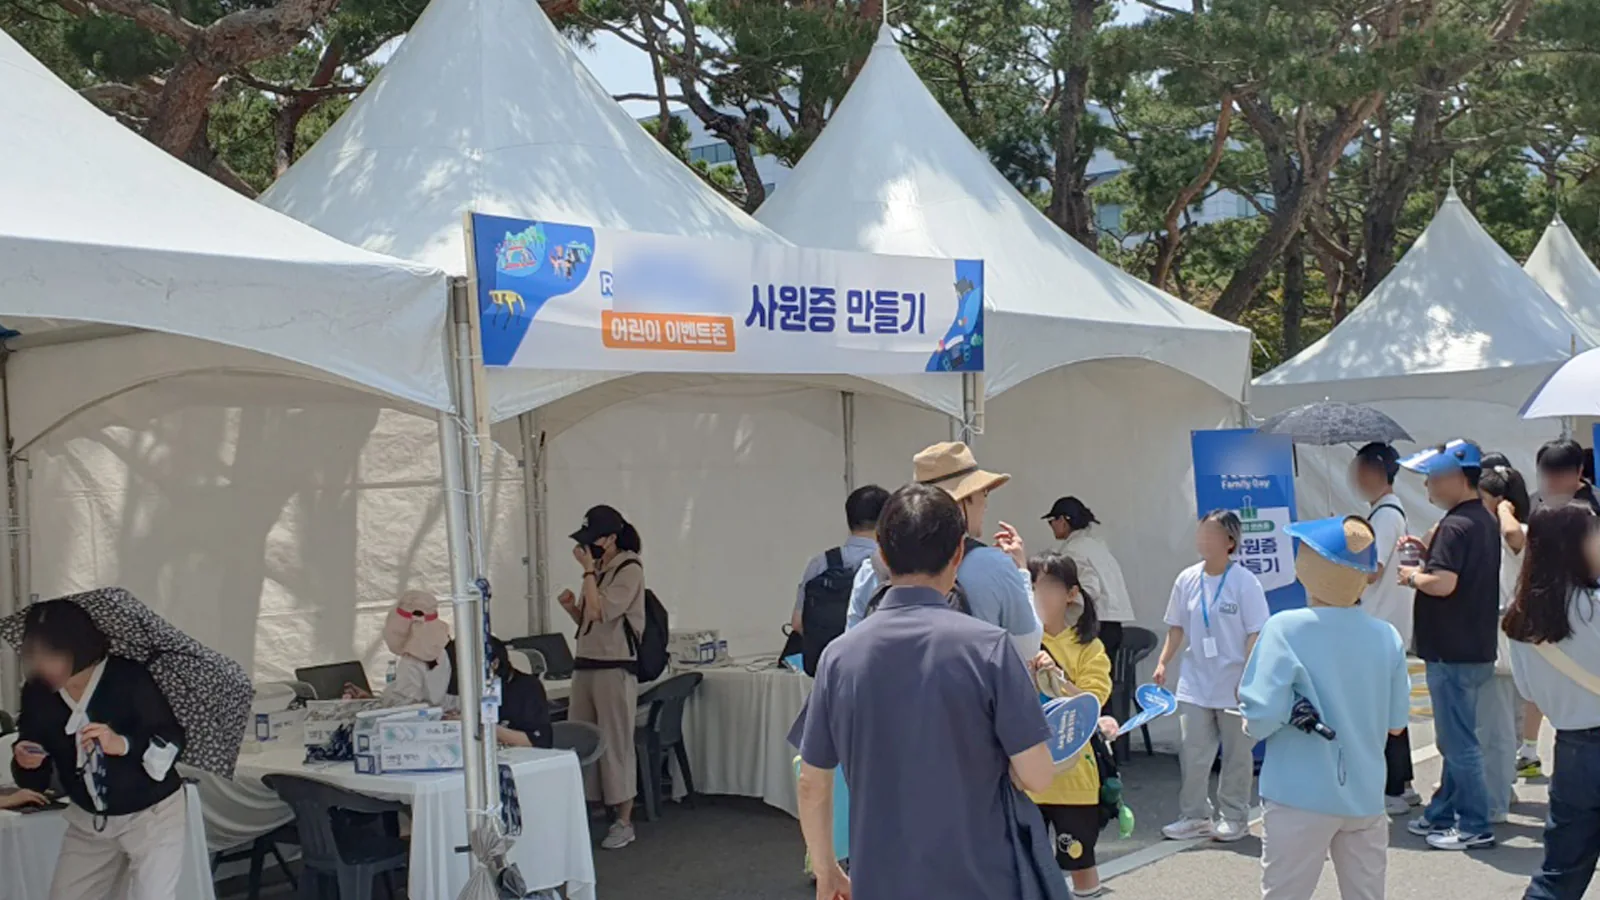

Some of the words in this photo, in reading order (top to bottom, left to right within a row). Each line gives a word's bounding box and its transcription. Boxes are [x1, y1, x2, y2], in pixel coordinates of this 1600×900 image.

[744, 284, 837, 333] 사원증
[845, 289, 926, 335] 만들기
[611, 317, 661, 344] 어린이
[665, 320, 728, 346] 이벤트존
[1221, 479, 1251, 490] Family
[1252, 479, 1270, 489] Day
